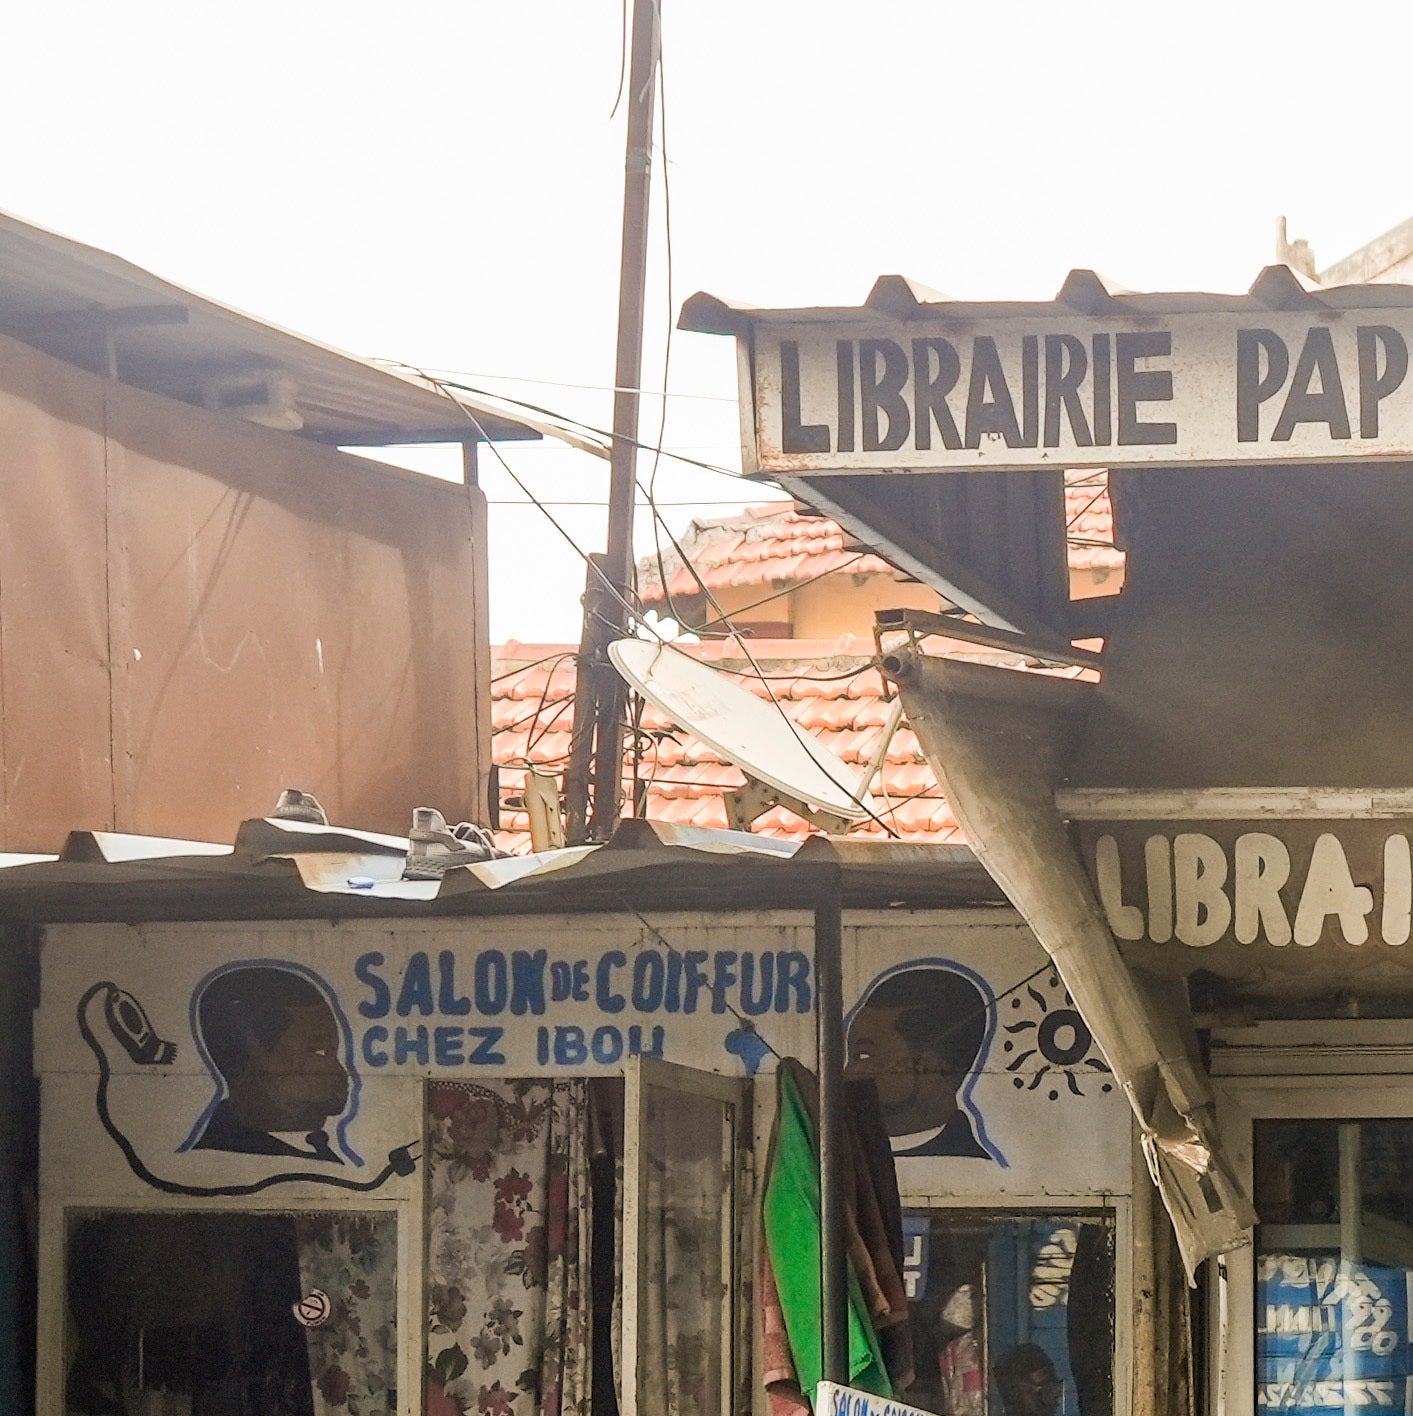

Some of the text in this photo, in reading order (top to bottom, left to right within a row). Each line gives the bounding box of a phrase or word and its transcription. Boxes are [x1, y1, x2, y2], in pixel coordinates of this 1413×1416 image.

[780, 331, 1177, 455] LIBRAIRIE
[355, 948, 548, 1018] SALON
[361, 1025, 665, 1067] CHEZ IBOU
